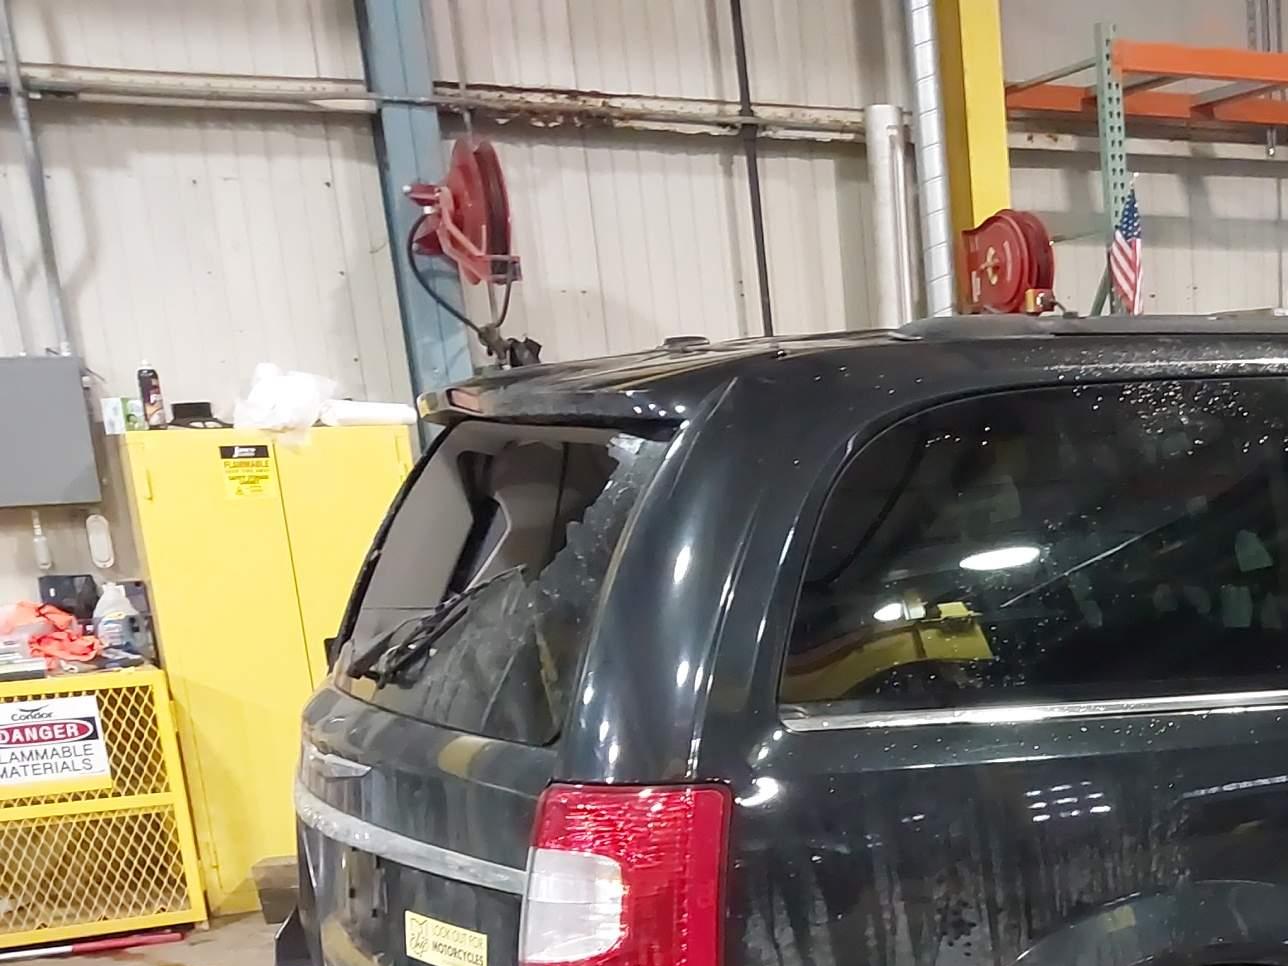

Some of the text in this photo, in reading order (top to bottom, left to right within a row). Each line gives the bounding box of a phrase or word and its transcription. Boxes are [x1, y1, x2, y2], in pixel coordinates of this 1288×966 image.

[10, 711, 53, 722] Condor
[0, 723, 79, 744] DANGER
[0, 758, 93, 779] MATERIALS
[432, 941, 484, 966] MOTORCYCLES
